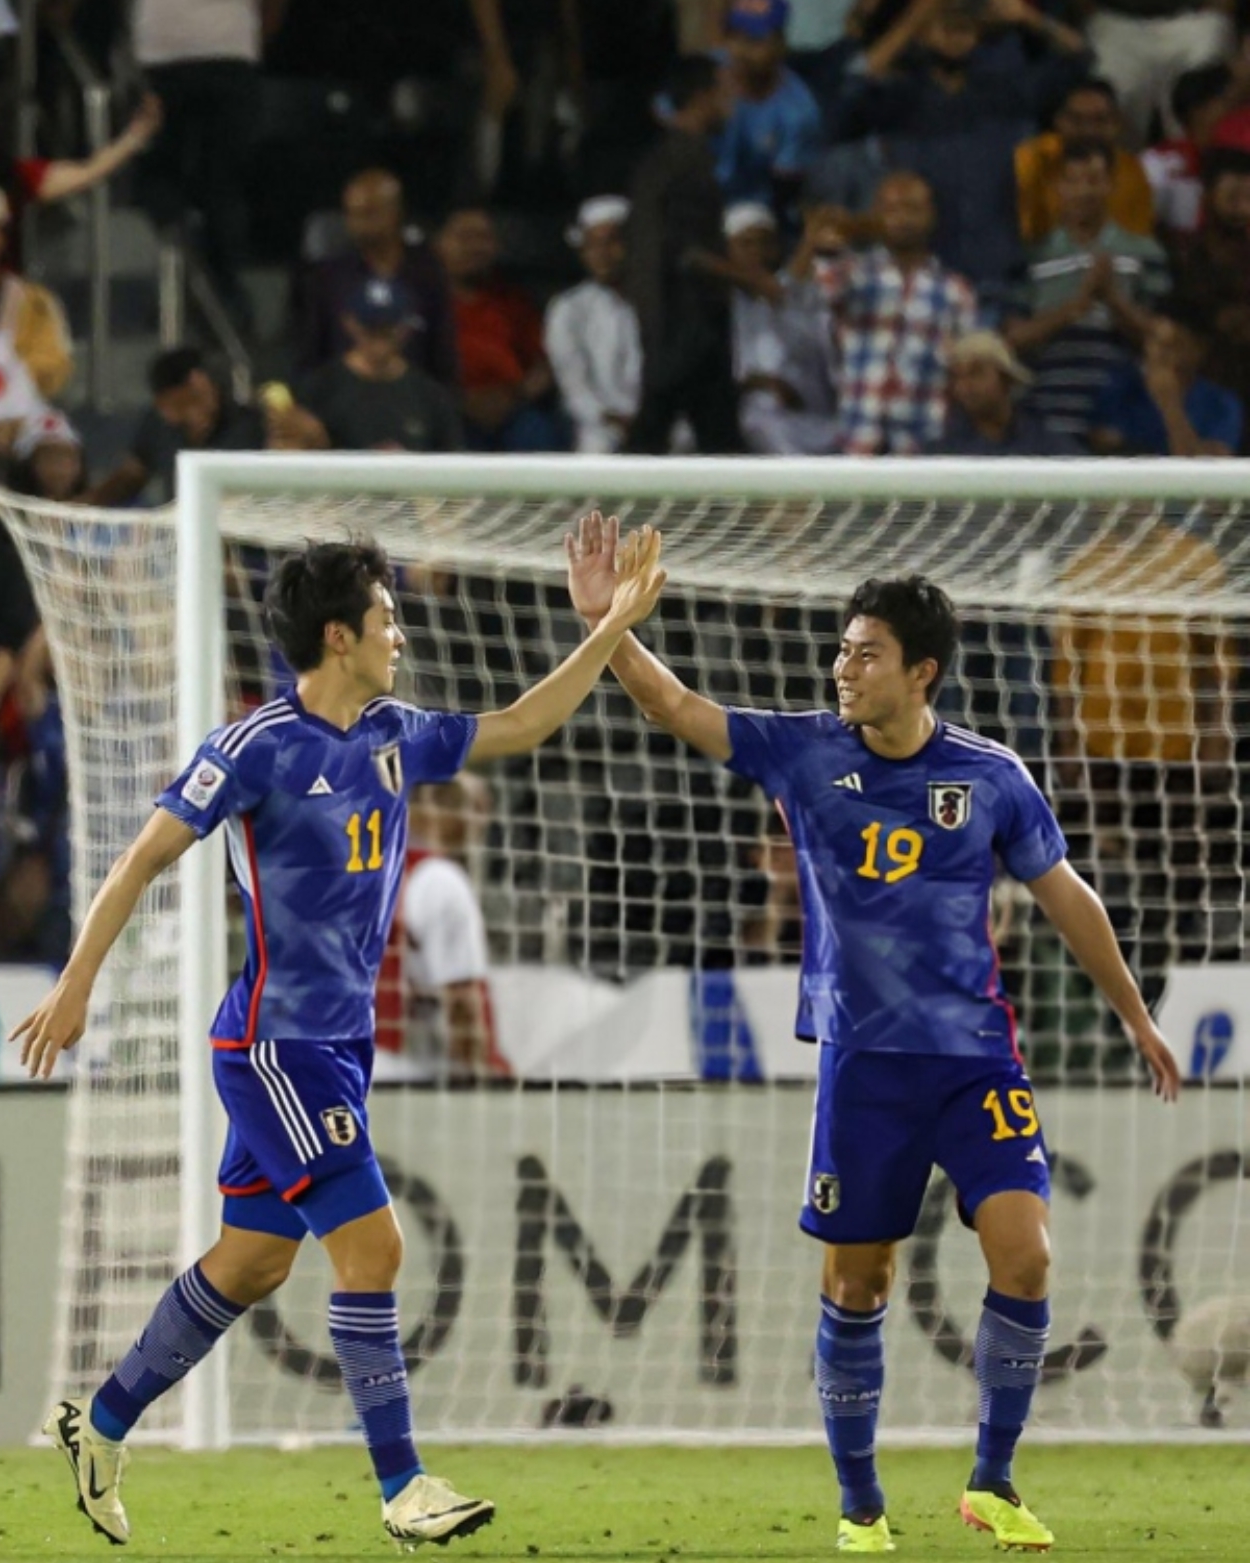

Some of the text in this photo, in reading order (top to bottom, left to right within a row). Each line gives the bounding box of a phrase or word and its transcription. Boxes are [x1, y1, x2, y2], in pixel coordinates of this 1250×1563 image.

[346, 809, 383, 872] 11
[857, 821, 923, 883] 19
[983, 1089, 1040, 1141] 19
